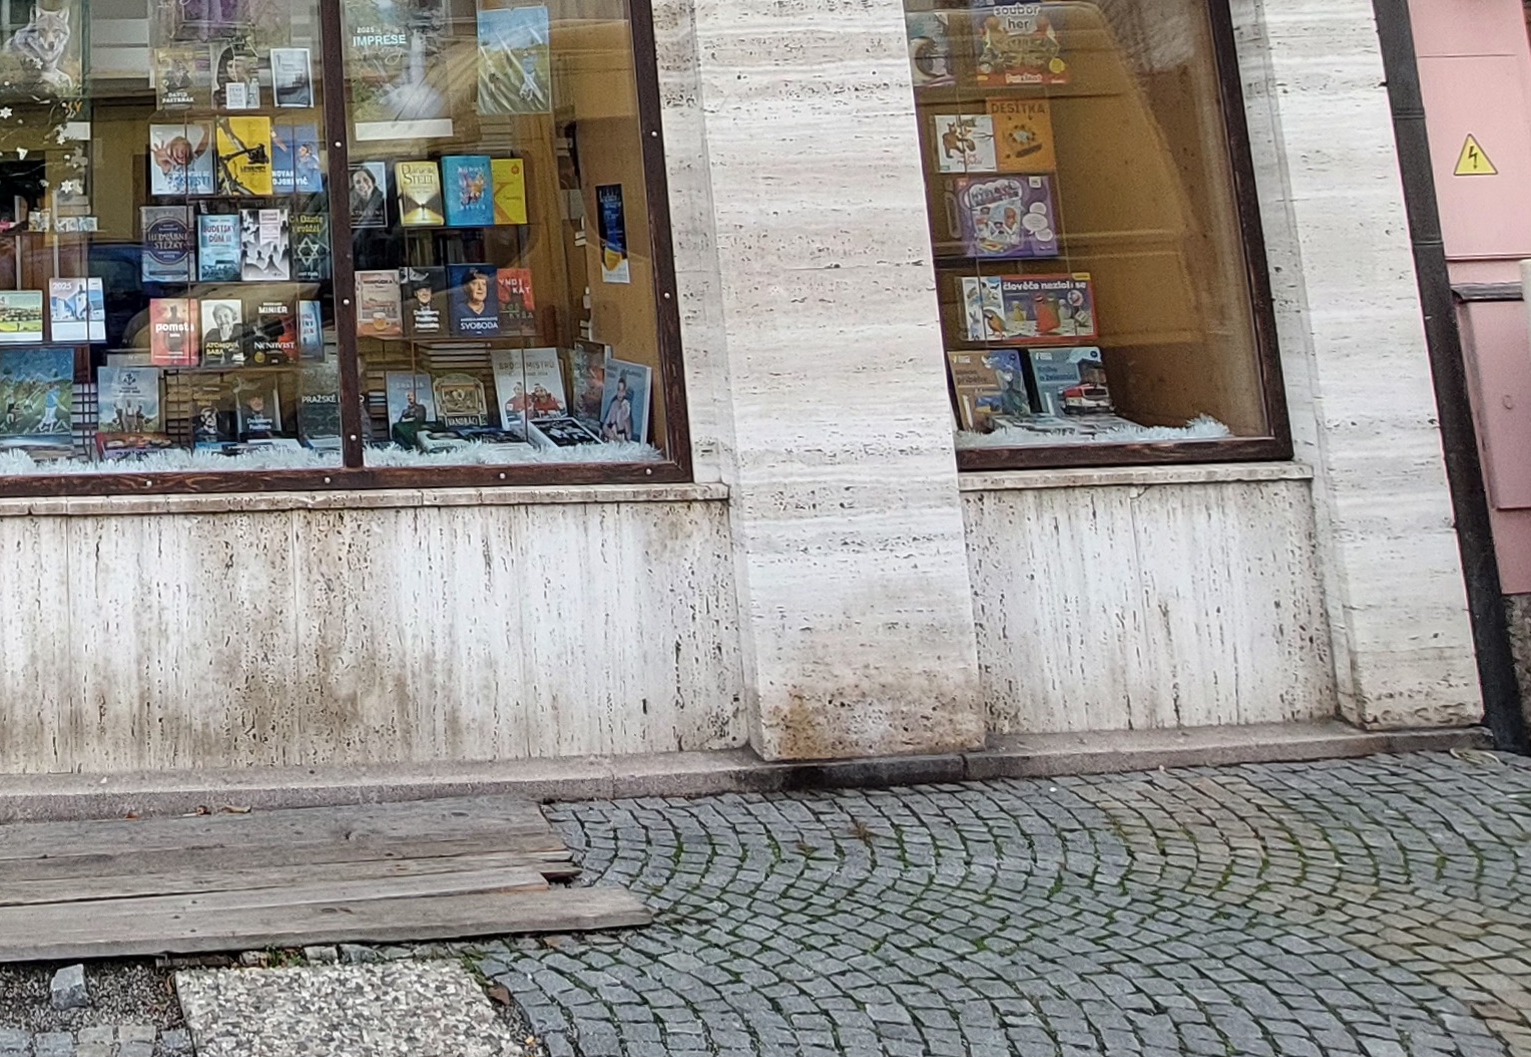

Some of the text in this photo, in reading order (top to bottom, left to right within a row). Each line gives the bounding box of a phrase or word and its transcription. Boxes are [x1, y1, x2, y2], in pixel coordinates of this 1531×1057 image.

[994, 4, 1041, 16] soubor
[1007, 18, 1030, 30] her
[353, 34, 407, 47] IMPRESE
[991, 101, 1046, 114] DESÍTKA
[52, 281, 72, 290] 2025
[258, 306, 289, 314] MINIER
[460, 322, 499, 330] SVOBODA
